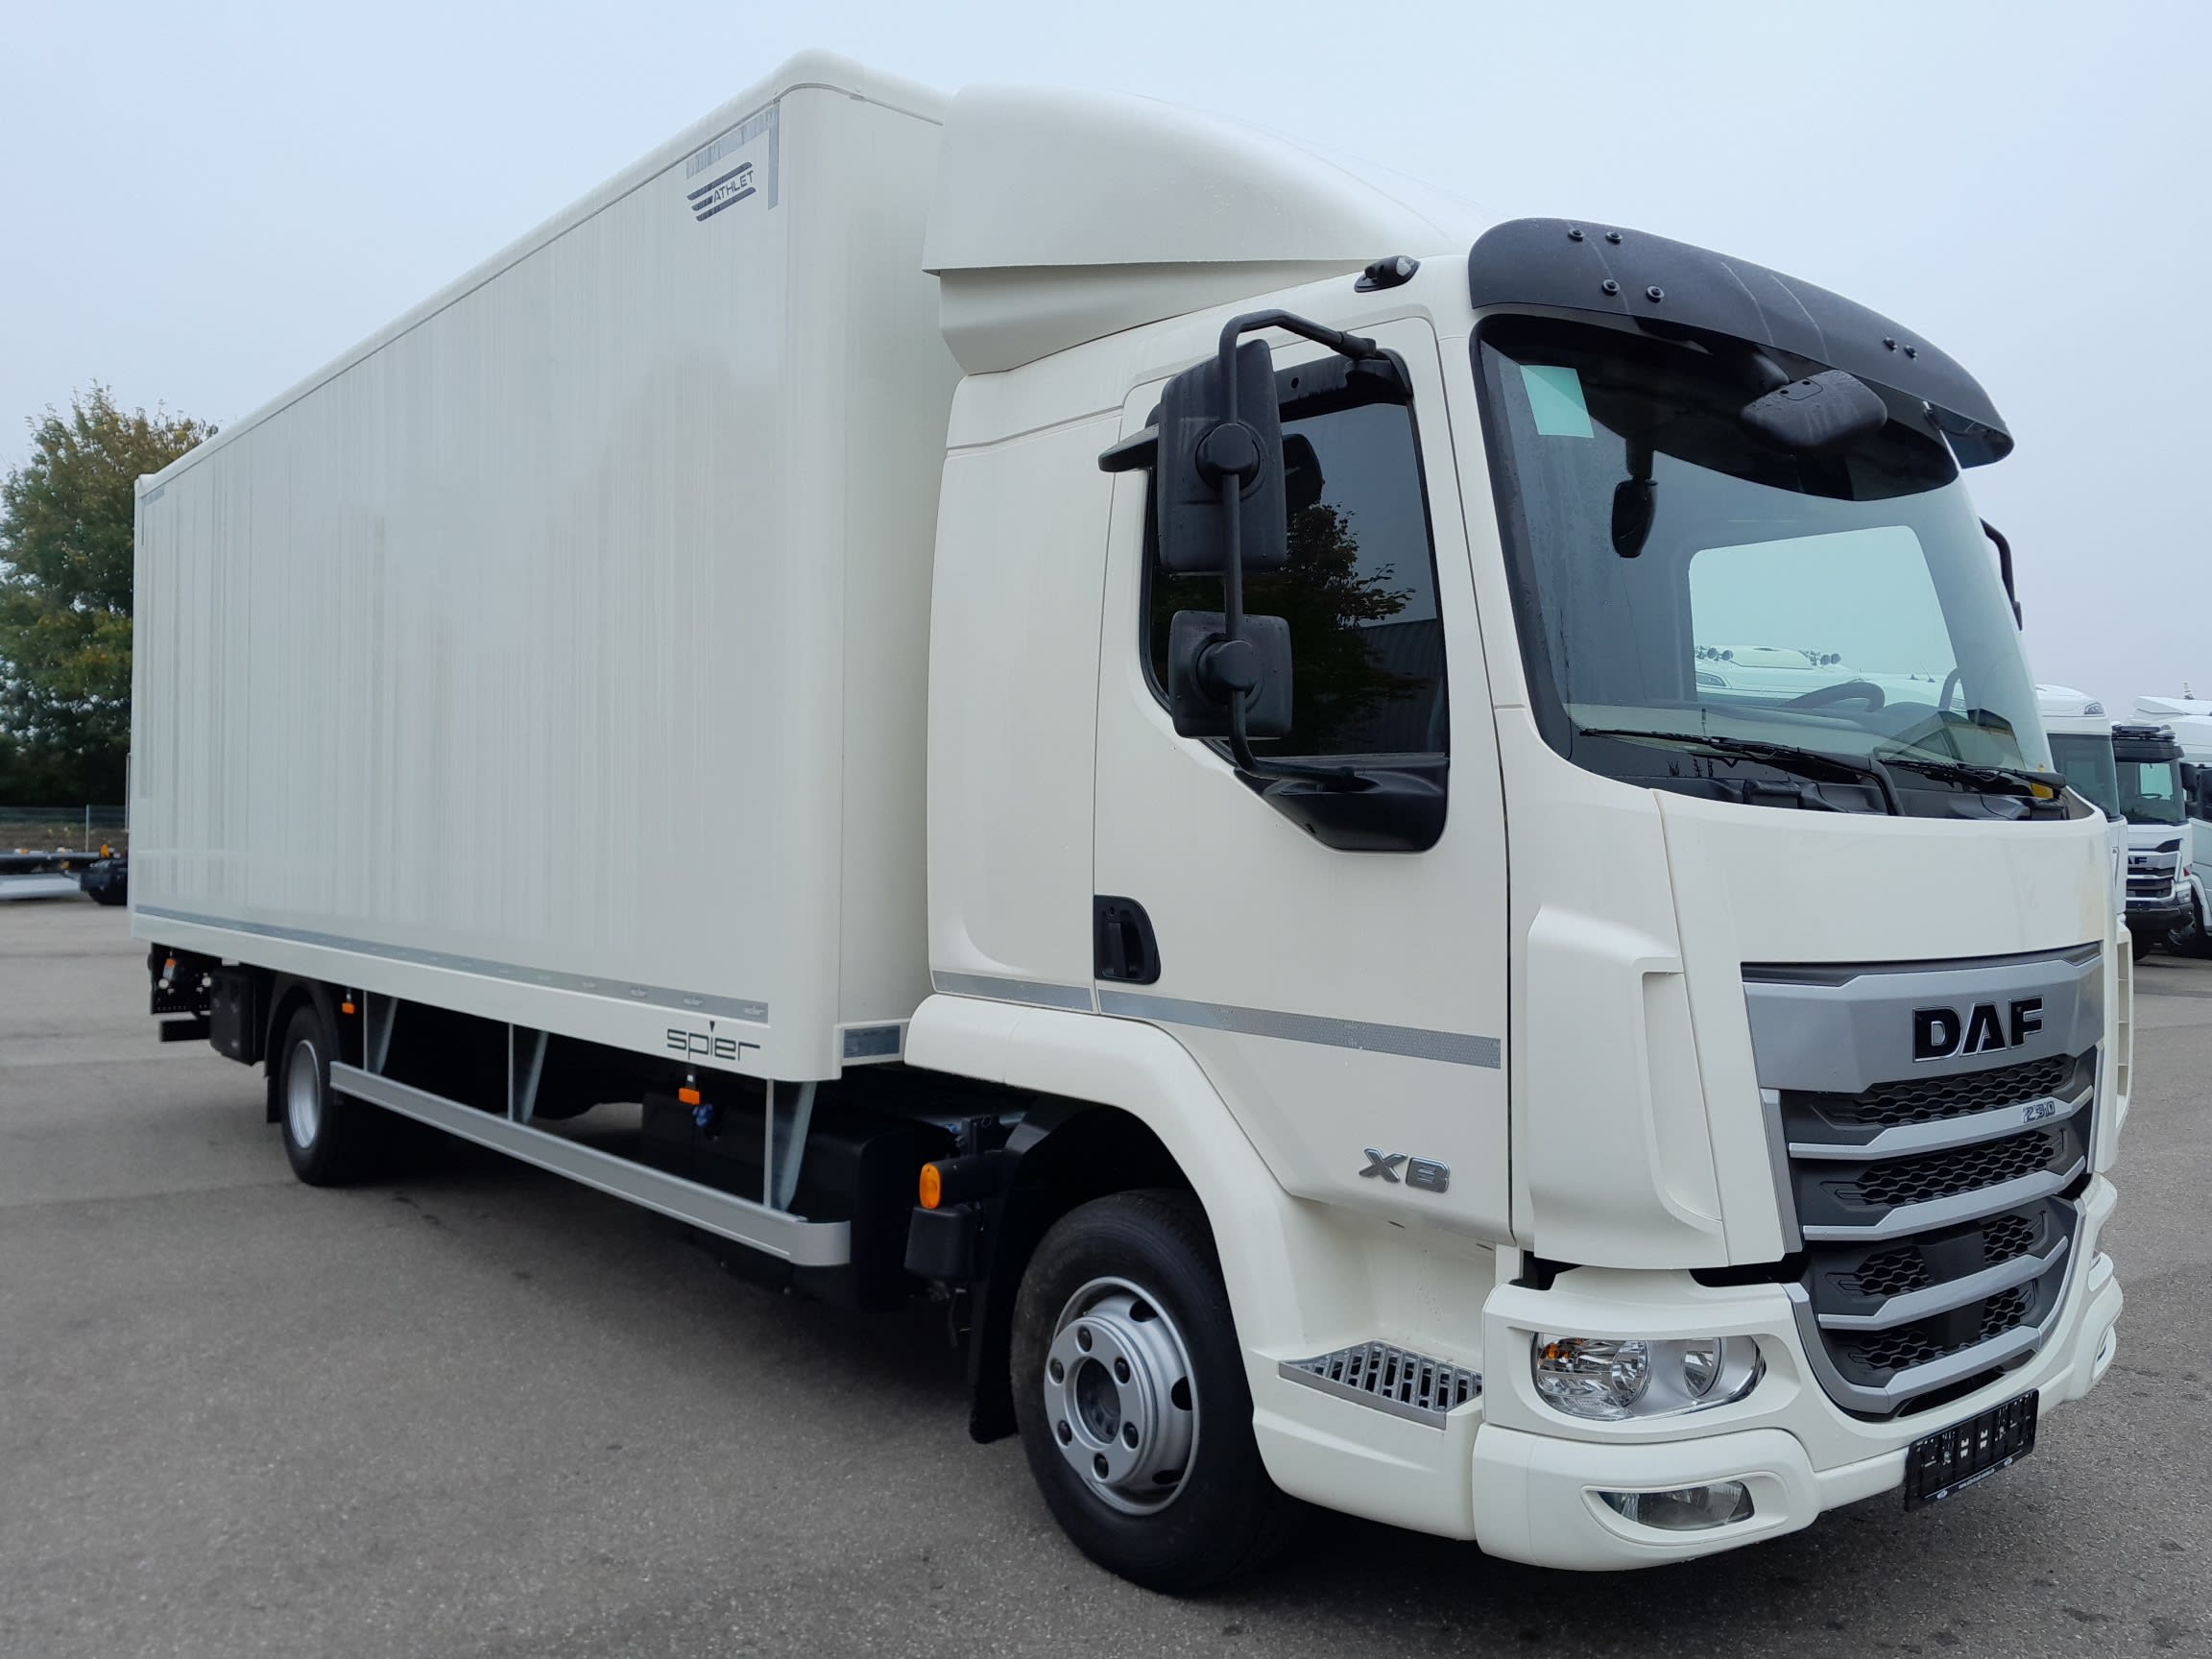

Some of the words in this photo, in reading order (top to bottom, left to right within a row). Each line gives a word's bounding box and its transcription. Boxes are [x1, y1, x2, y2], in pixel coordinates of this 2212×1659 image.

[713, 170, 754, 204] ATHLET
[666, 1020, 761, 1062] spier
[1912, 995, 2044, 1063] DAF
[2023, 1100, 2056, 1123] 230
[1358, 1146, 1451, 1194] XB
